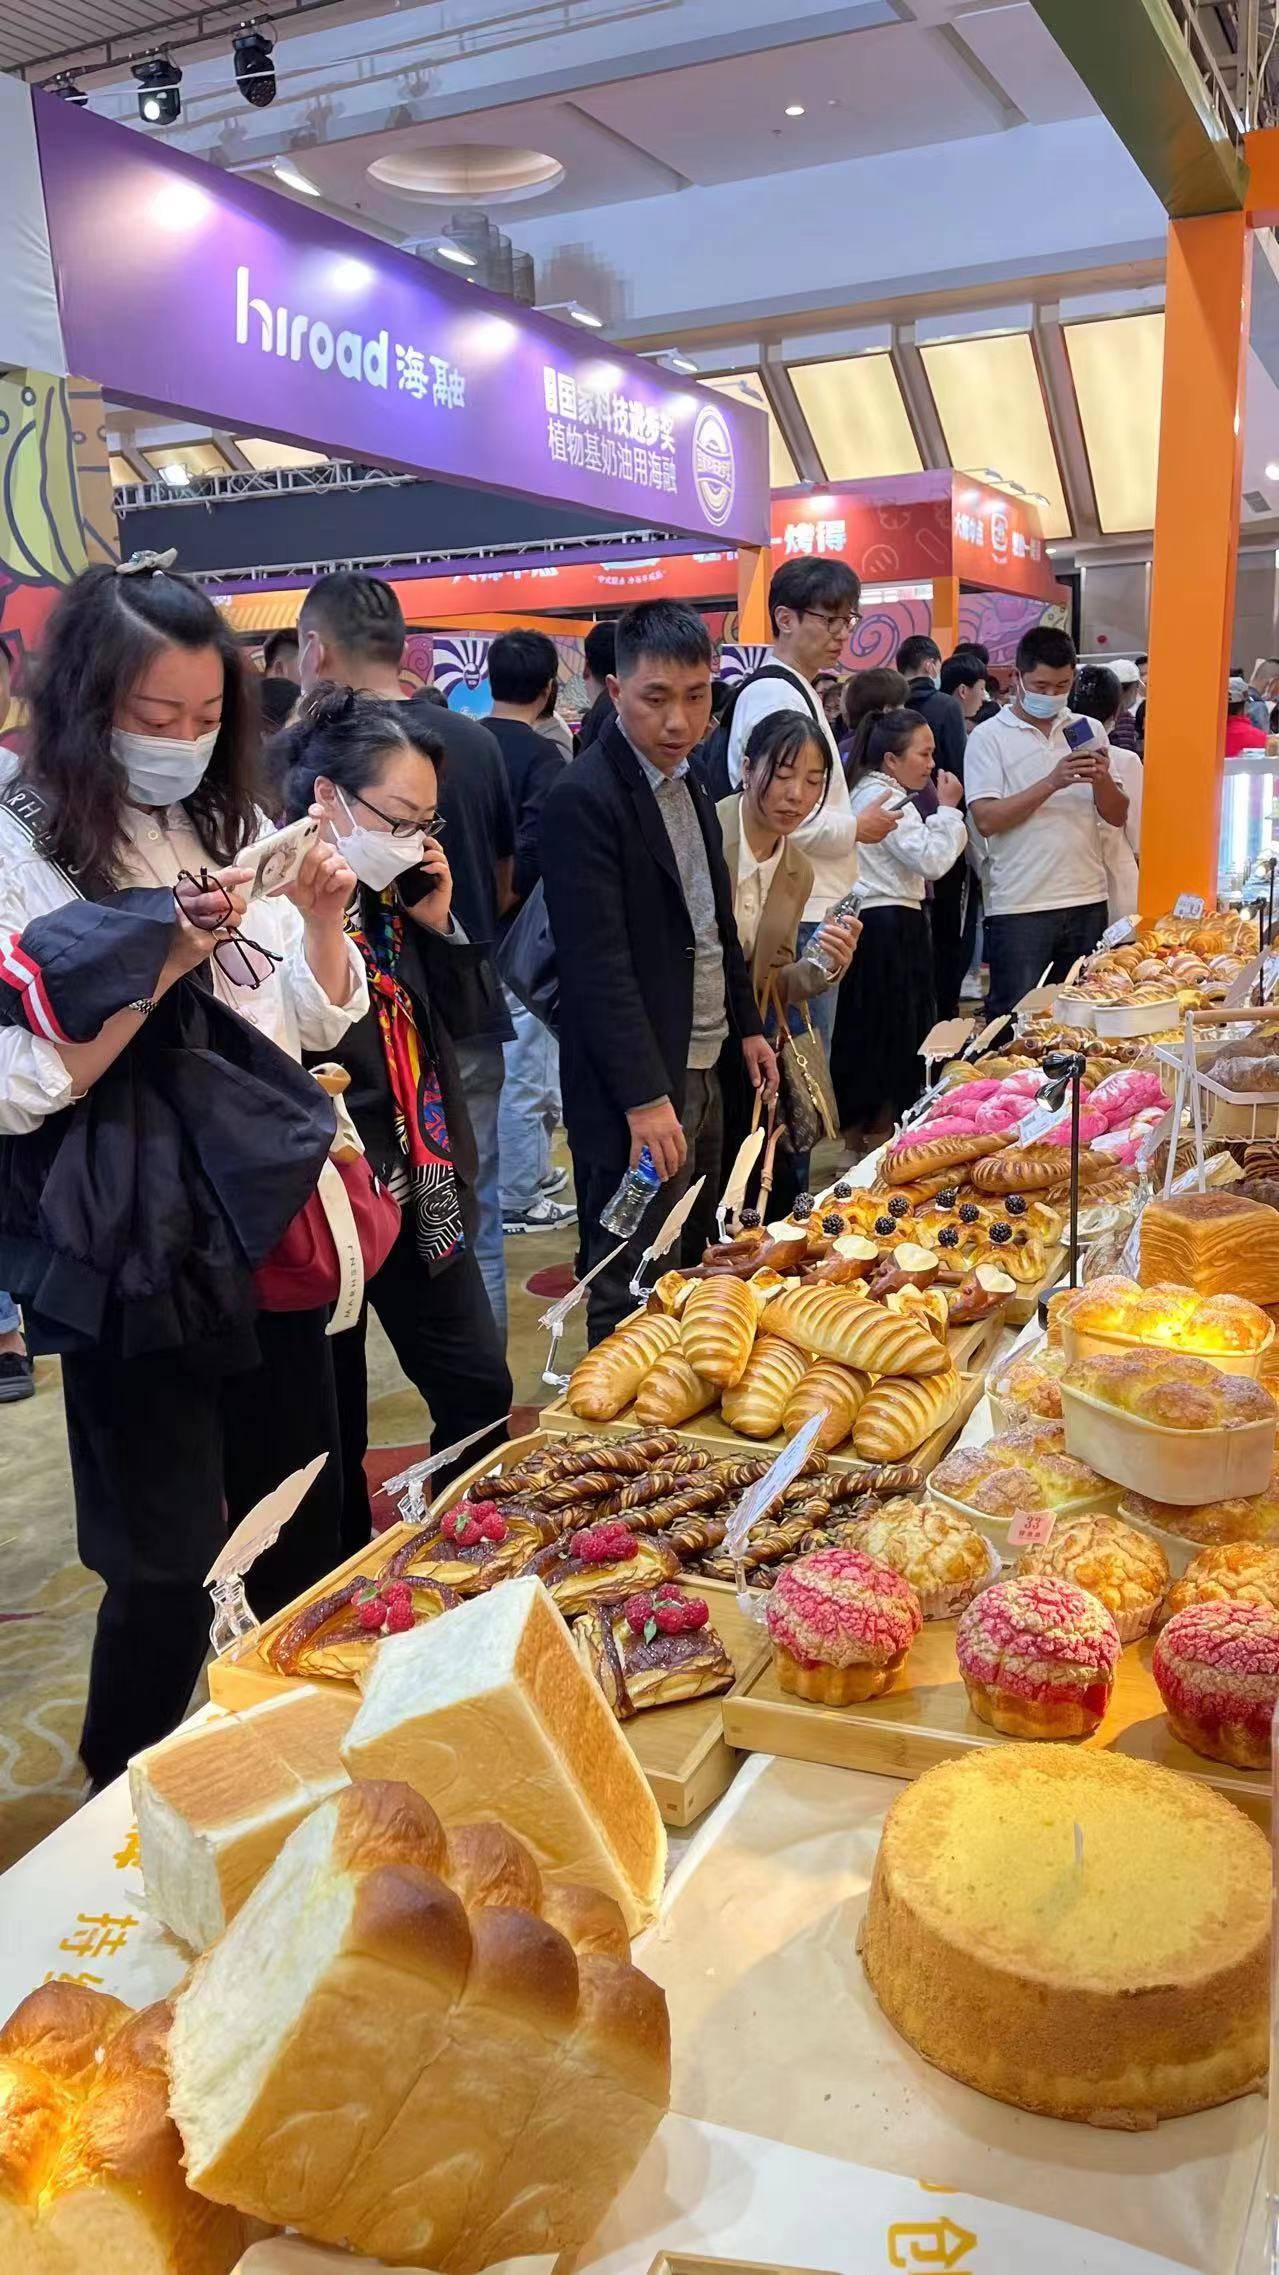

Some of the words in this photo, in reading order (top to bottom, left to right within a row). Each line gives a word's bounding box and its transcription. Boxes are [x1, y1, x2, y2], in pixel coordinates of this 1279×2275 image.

[236, 266, 389, 389] hiroad
[395, 343, 466, 409] 海融
[547, 417, 679, 494] 植物基奶油用海融
[1024, 1515, 1041, 1530] 33
